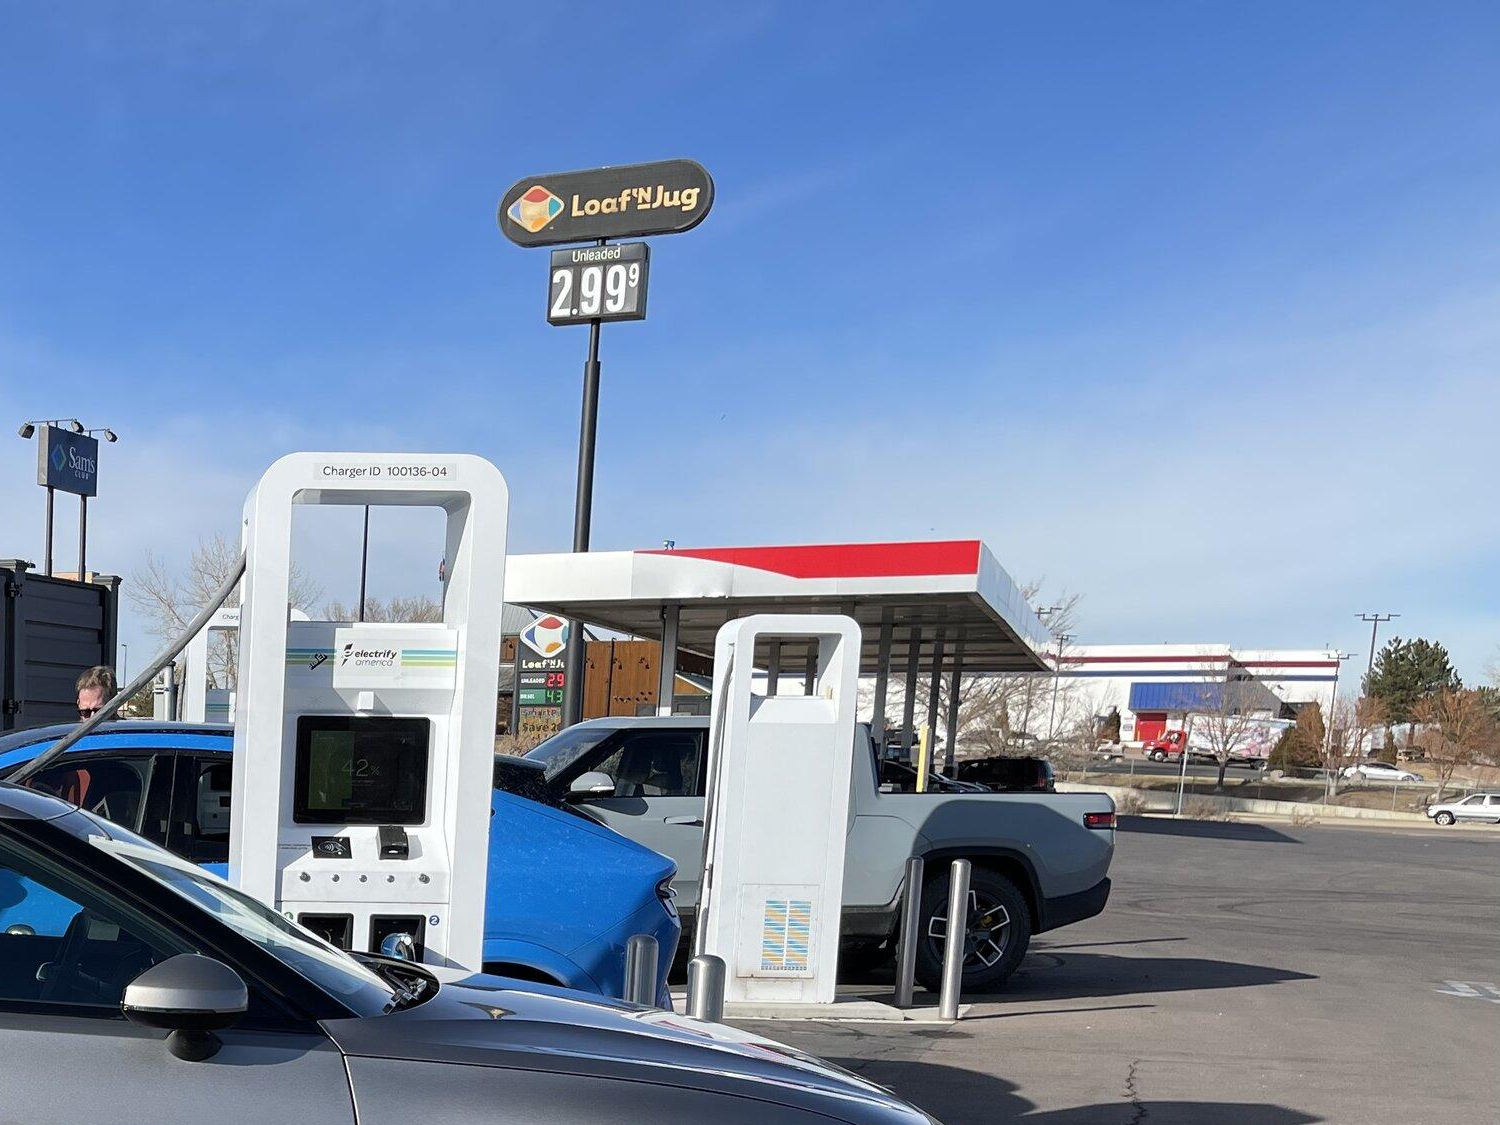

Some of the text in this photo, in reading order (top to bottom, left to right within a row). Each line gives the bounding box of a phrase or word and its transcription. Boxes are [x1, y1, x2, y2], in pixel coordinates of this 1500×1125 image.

[572, 247, 620, 262] Unleaded
[68, 446, 96, 474] Sam's
[322, 465, 448, 478] Charger ID 100136-04
[222, 612, 239, 621] Charg
[354, 649, 398, 660] electrify
[355, 658, 394, 667] america
